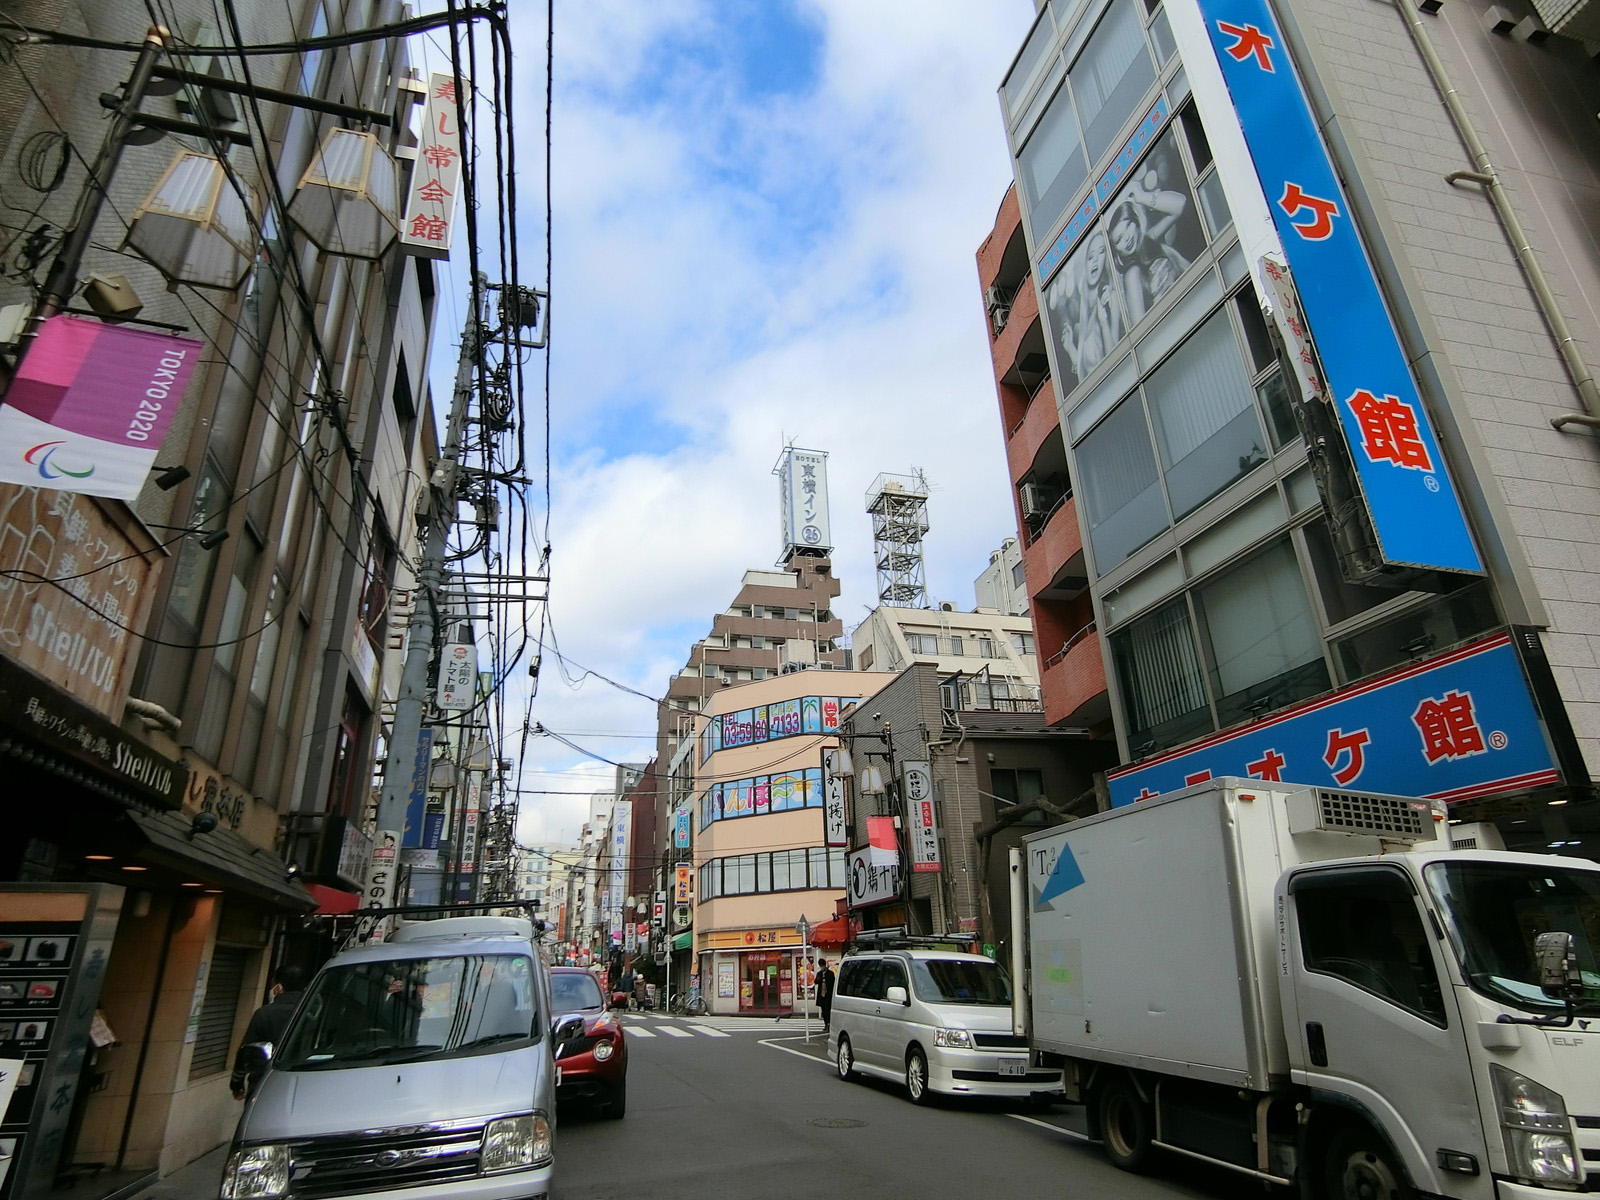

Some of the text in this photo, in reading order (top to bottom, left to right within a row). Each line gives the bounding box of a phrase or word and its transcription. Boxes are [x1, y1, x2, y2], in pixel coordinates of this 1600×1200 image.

[409, 80, 458, 241] 寿し常会館
[1103, 110, 1160, 191] カラオケ館
[126, 349, 187, 442] TOKYO 2020
[795, 456, 821, 464] HOTEL
[801, 464, 817, 524] 東横イン
[443, 660, 458, 693] トマト麺
[458, 661, 472, 686] 太陽の
[723, 714, 736, 726] TEL
[434, 818, 442, 836] TOKYO
[614, 823, 625, 880] 東横INN
[678, 881, 687, 898] 松屋
[678, 907, 688, 925] 歯科
[757, 931, 777, 943] 松屋
[1551, 1036, 1584, 1047] ELF
